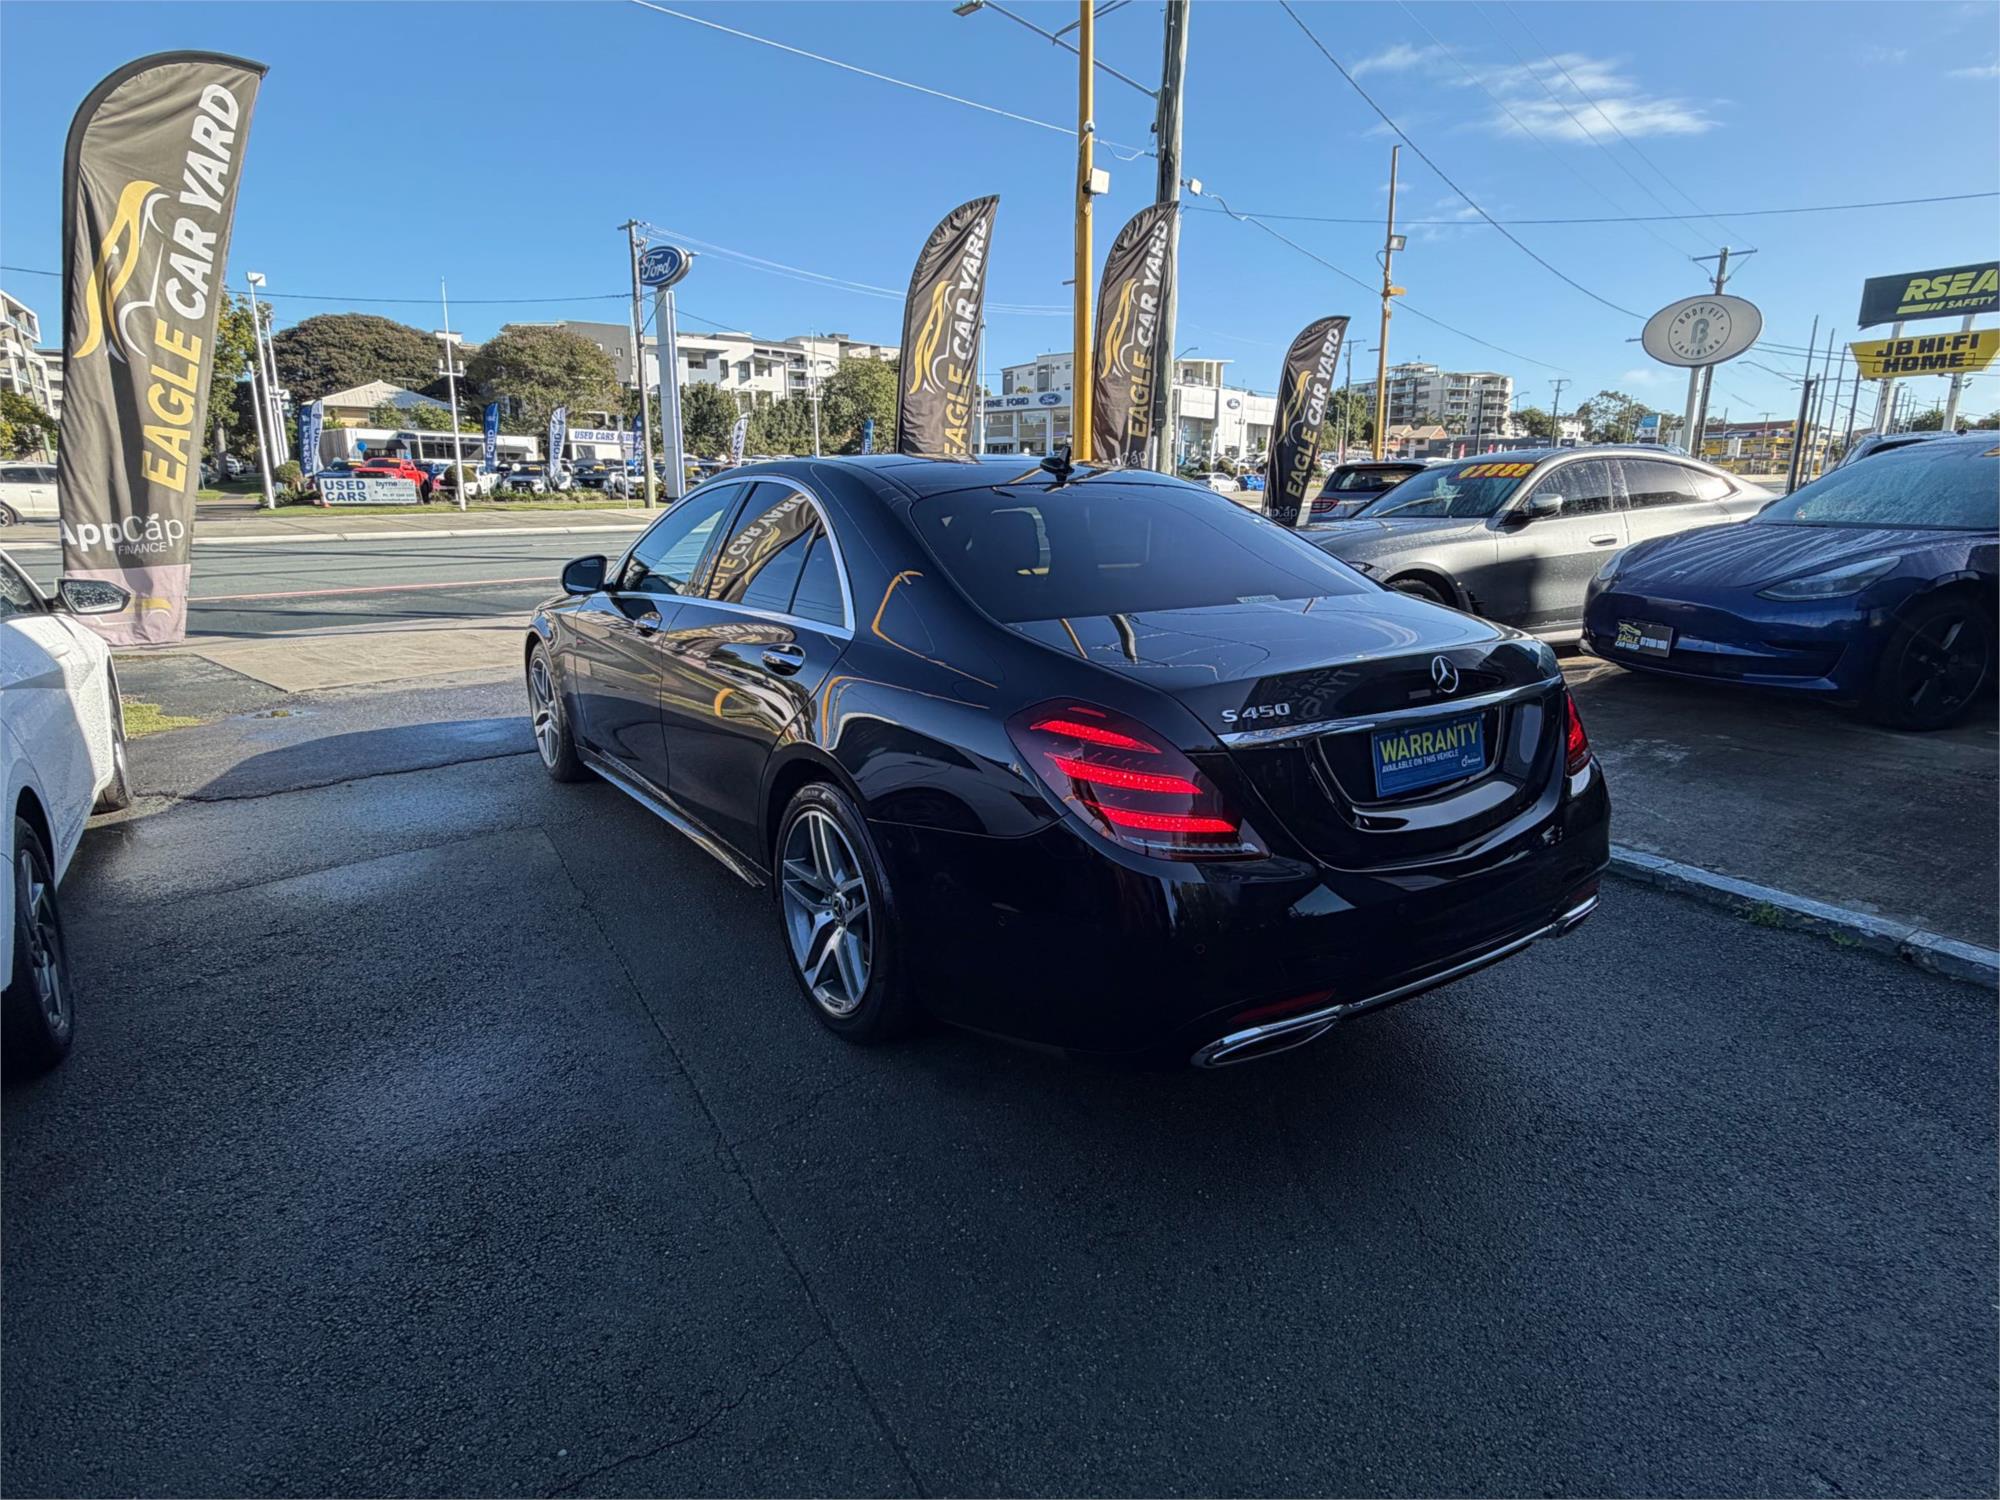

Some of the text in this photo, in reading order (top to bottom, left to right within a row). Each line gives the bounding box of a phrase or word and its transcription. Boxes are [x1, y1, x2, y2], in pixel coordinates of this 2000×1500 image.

[641, 254, 671, 279] Ford
[142, 84, 239, 493] EAGLE CAR YARD
[1901, 268, 1999, 302] RSEA
[1945, 295, 1997, 309] SAFETY
[1137, 292, 1158, 347] CAR
[1678, 306, 1725, 325] BODY FIT
[953, 297, 977, 361] CAR
[1675, 340, 1720, 356] TRAINING
[1875, 340, 1914, 357] JB
[1882, 352, 1966, 373] HOME
[1007, 397, 1030, 406] FORD
[1128, 350, 1152, 438] EAGLE
[1286, 328, 1340, 498] EAGLE CAR YARD
[574, 431, 594, 440] USED
[596, 431, 615, 440] CARS
[554, 433, 562, 460] FORD
[324, 480, 366, 490] USED
[325, 491, 367, 501] CARS
[118, 542, 168, 555] FINANCE
[1221, 702, 1291, 723] S 450
[1380, 721, 1478, 763] WARRANTY
[1382, 759, 1413, 773] AVAILABLE
[1413, 757, 1423, 766] ON
[1423, 755, 1436, 765] THIS
[1436, 749, 1460, 761] VEHICLE
